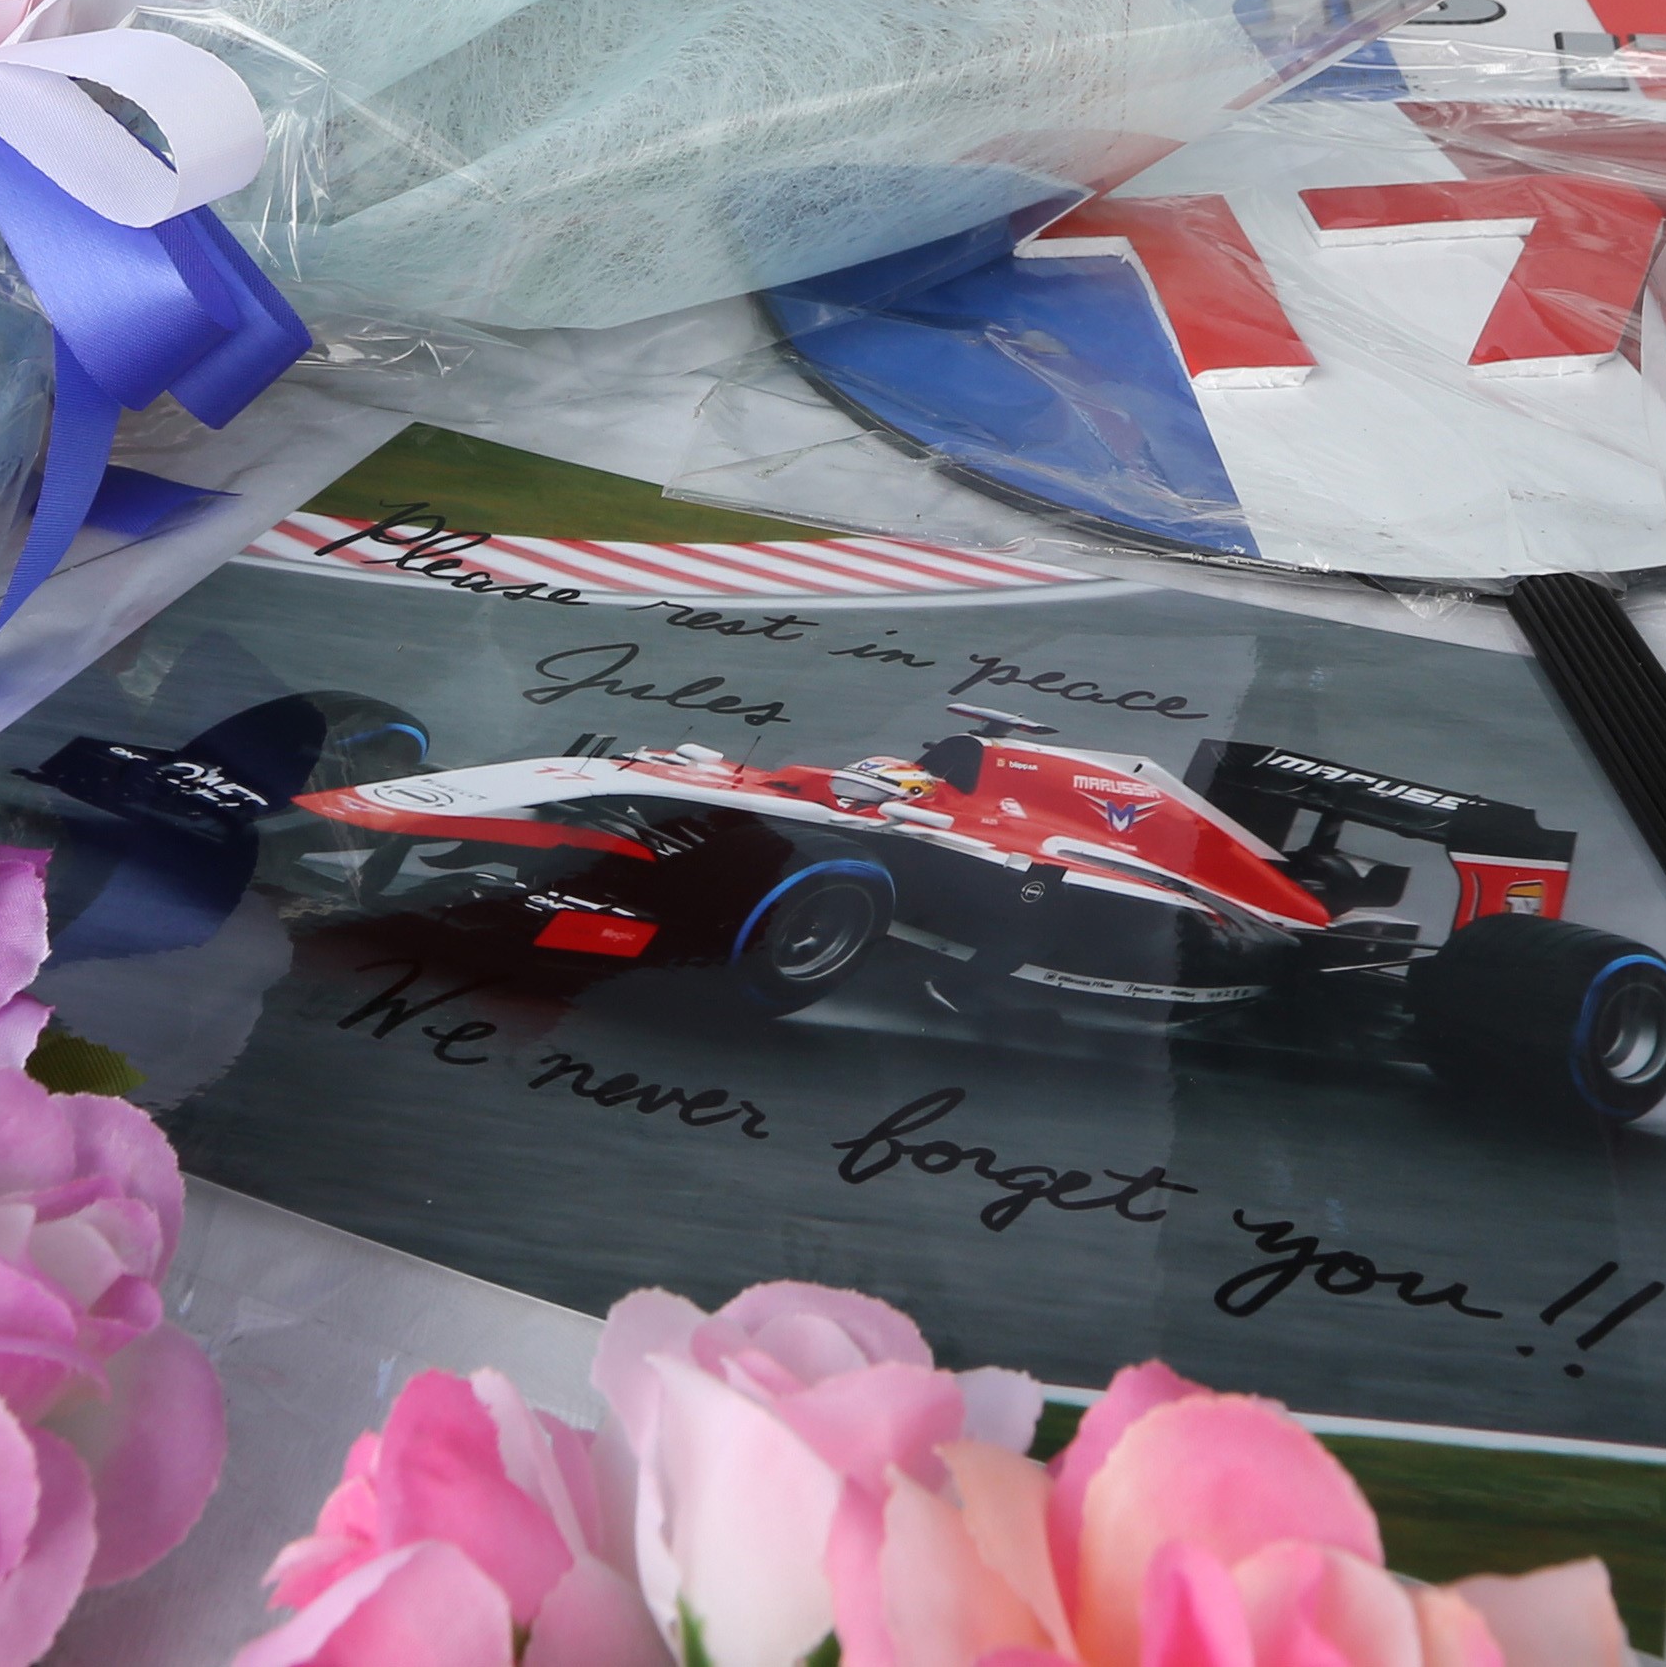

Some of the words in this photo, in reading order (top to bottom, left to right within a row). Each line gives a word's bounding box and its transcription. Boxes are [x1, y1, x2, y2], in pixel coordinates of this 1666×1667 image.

[1015, 173, 1666, 391] 17
[315, 500, 591, 607] Please
[627, 596, 823, 642] rest
[828, 629, 935, 670] in
[947, 653, 1211, 721] peace
[523, 642, 792, 726] Jules
[1073, 774, 1161, 799] MARUSSIA
[337, 958, 491, 1068] We
[531, 1044, 771, 1140] never
[832, 1087, 1200, 1230] forget
